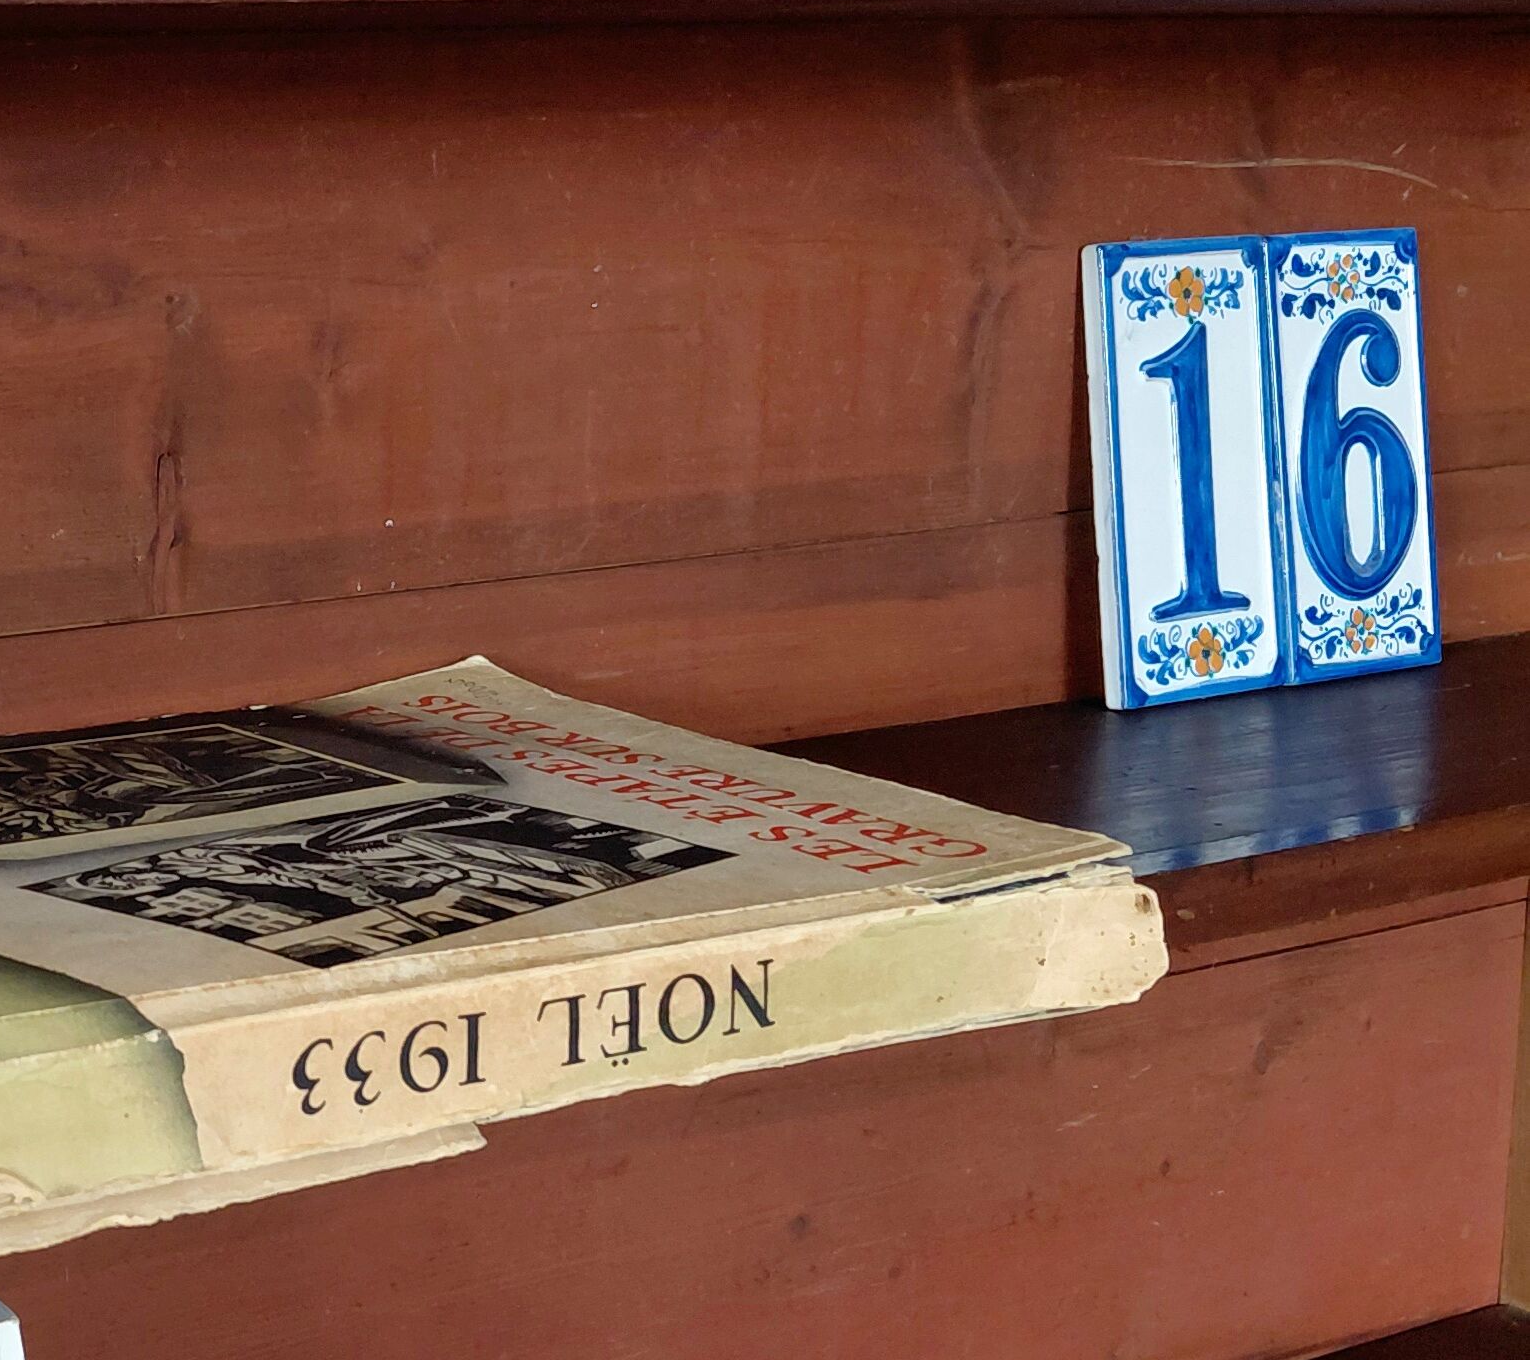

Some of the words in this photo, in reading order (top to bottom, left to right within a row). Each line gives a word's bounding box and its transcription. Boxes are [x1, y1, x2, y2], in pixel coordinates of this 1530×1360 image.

[1138, 308, 1418, 623] 16
[338, 705, 423, 727] LA
[402, 695, 558, 736] BOIS
[406, 726, 511, 750] DE
[534, 731, 666, 765] SUR
[491, 749, 767, 824] ÉTAPES
[647, 767, 989, 862] GRAVURE
[748, 822, 922, 874] LES
[539, 957, 777, 1069] NOËL
[290, 1011, 488, 1117] 1933
